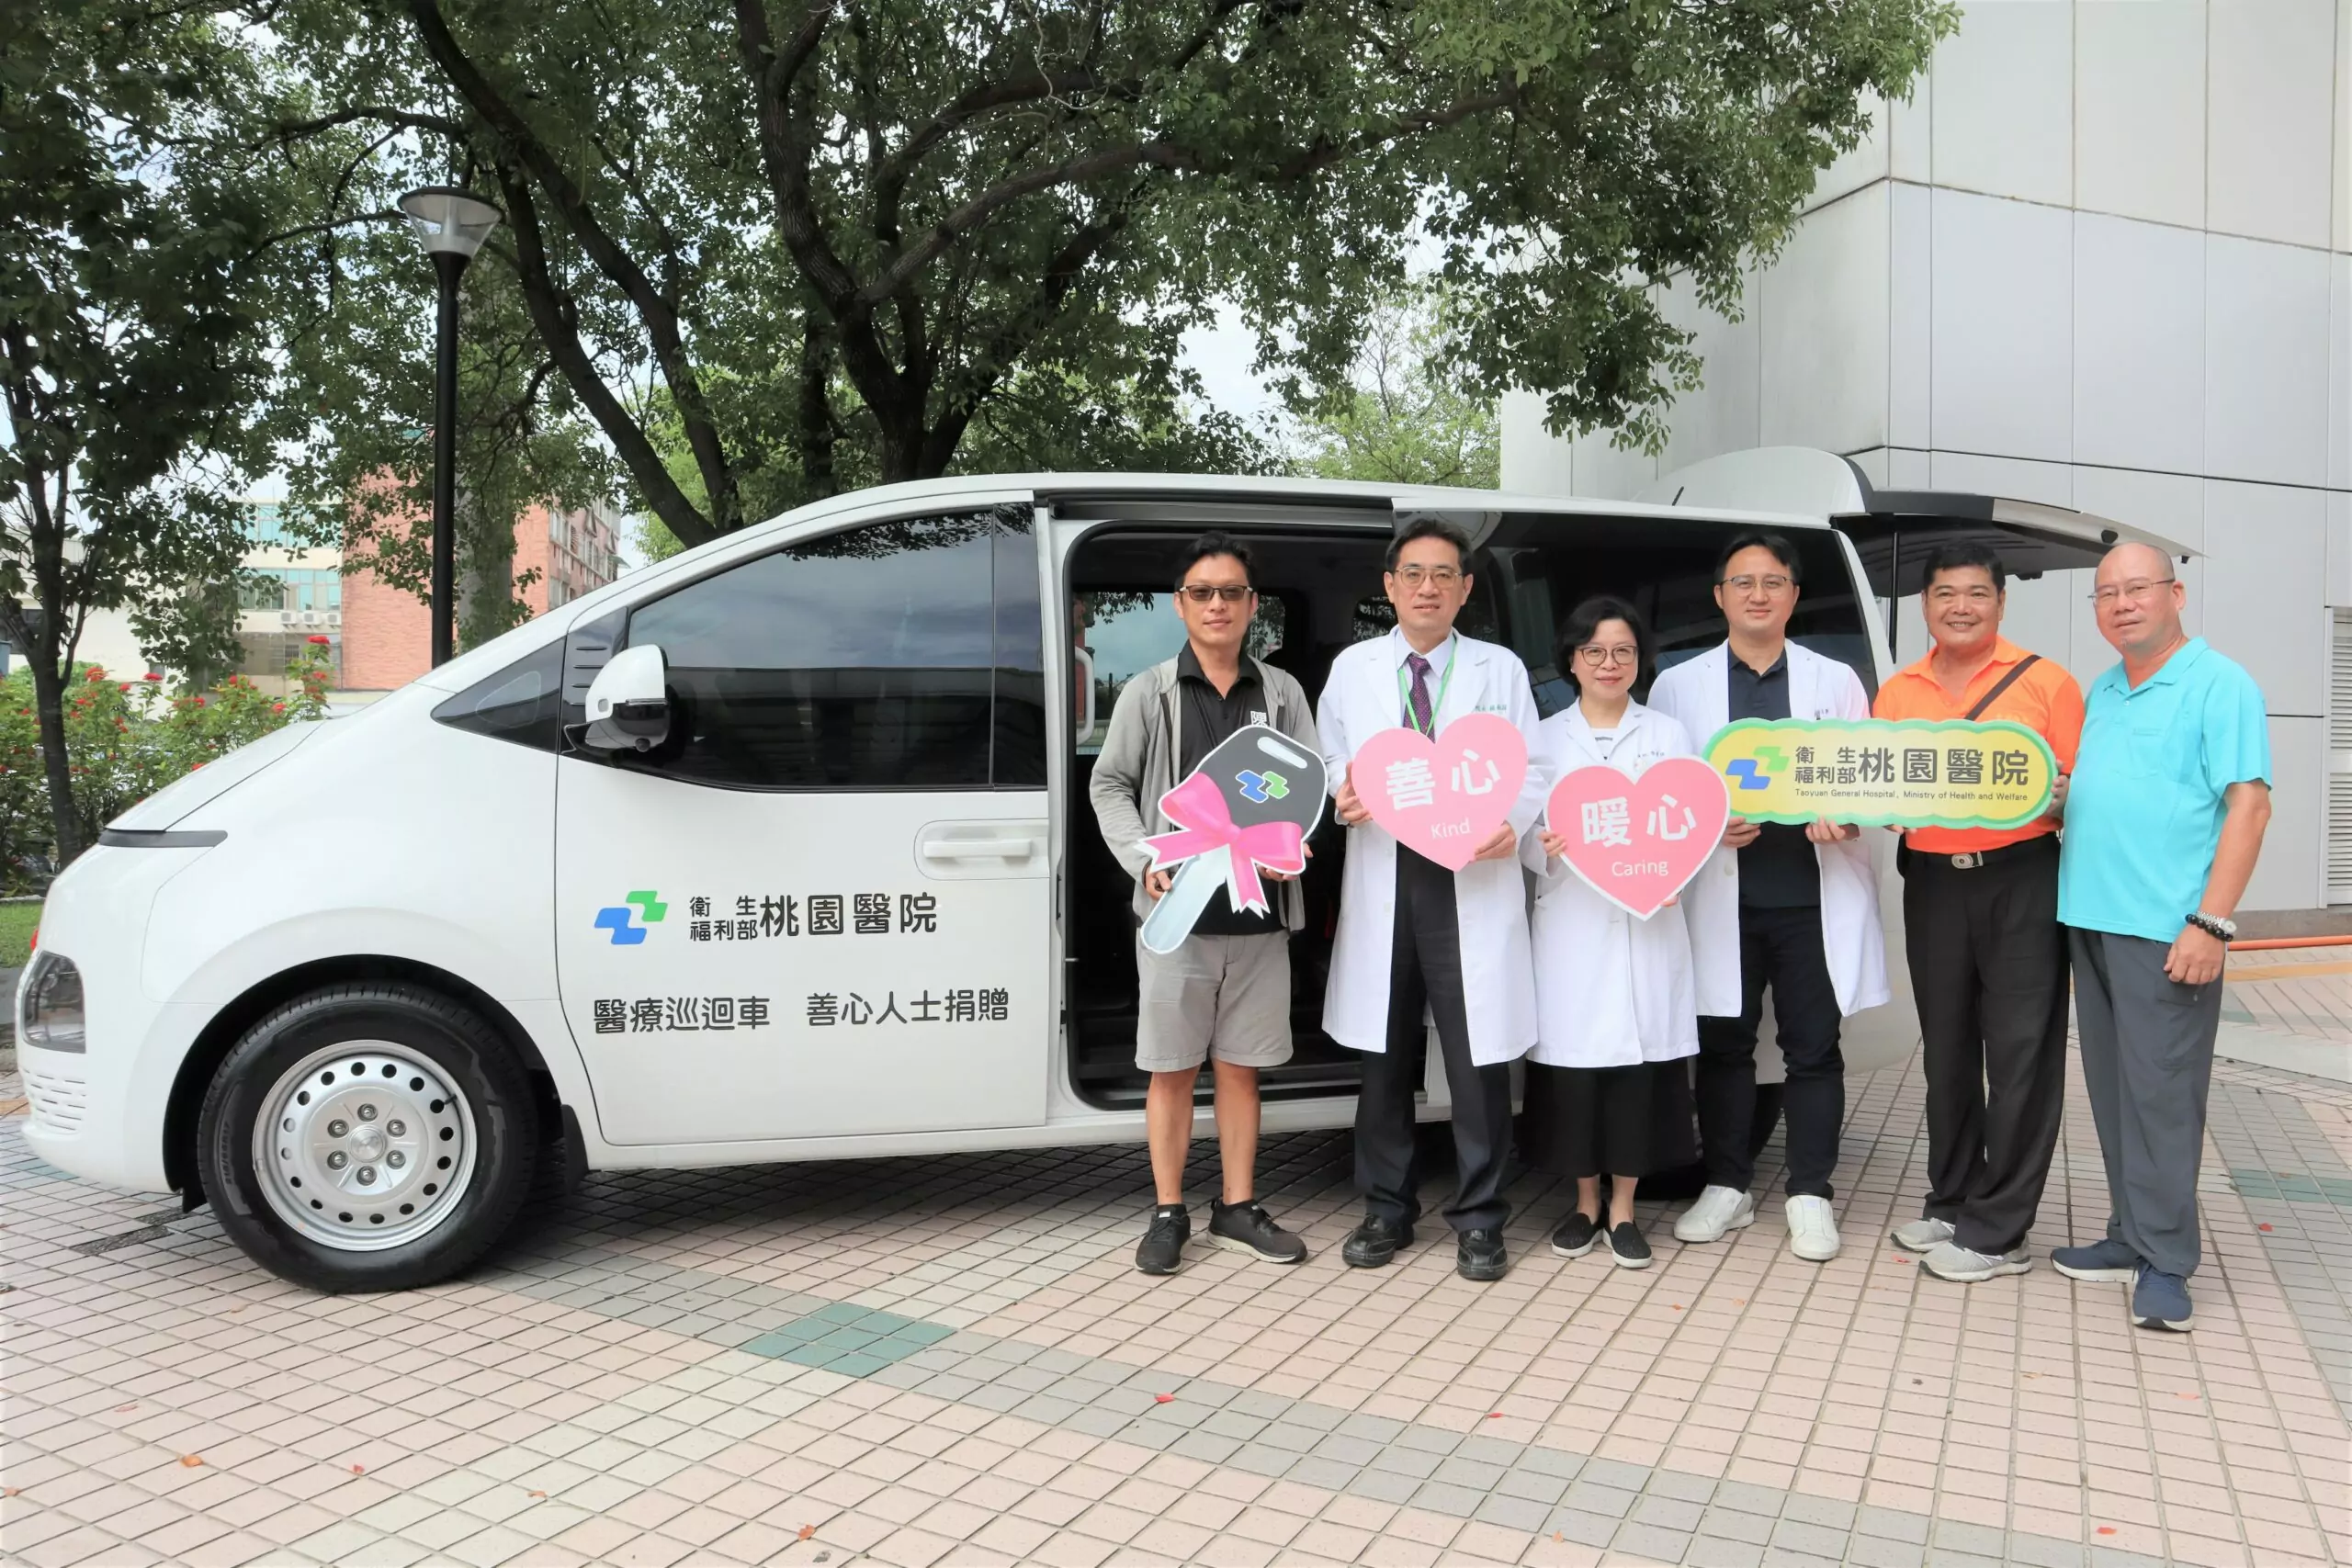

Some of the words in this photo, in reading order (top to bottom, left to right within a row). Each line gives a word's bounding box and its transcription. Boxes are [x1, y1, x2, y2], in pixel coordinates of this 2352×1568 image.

[1385, 748, 1501, 811] 善心
[1794, 766, 1857, 784] 福利部
[1859, 747, 2029, 785] 桃園醫院
[1795, 789, 1828, 797] Taoyuan
[1830, 789, 1860, 797] General
[1903, 791, 1936, 800] Ministry
[1949, 792, 1975, 800] Health
[1996, 793, 2028, 801] Welfare
[1430, 818, 1471, 840] Kind
[1580, 793, 1698, 848] 暖心
[1611, 860, 1669, 877] Caring
[759, 892, 938, 937] 桃園醫院
[689, 919, 758, 942] 福利部
[593, 996, 771, 1034] 醫療巡迴車
[806, 987, 1010, 1027] 善心人士捐贈
